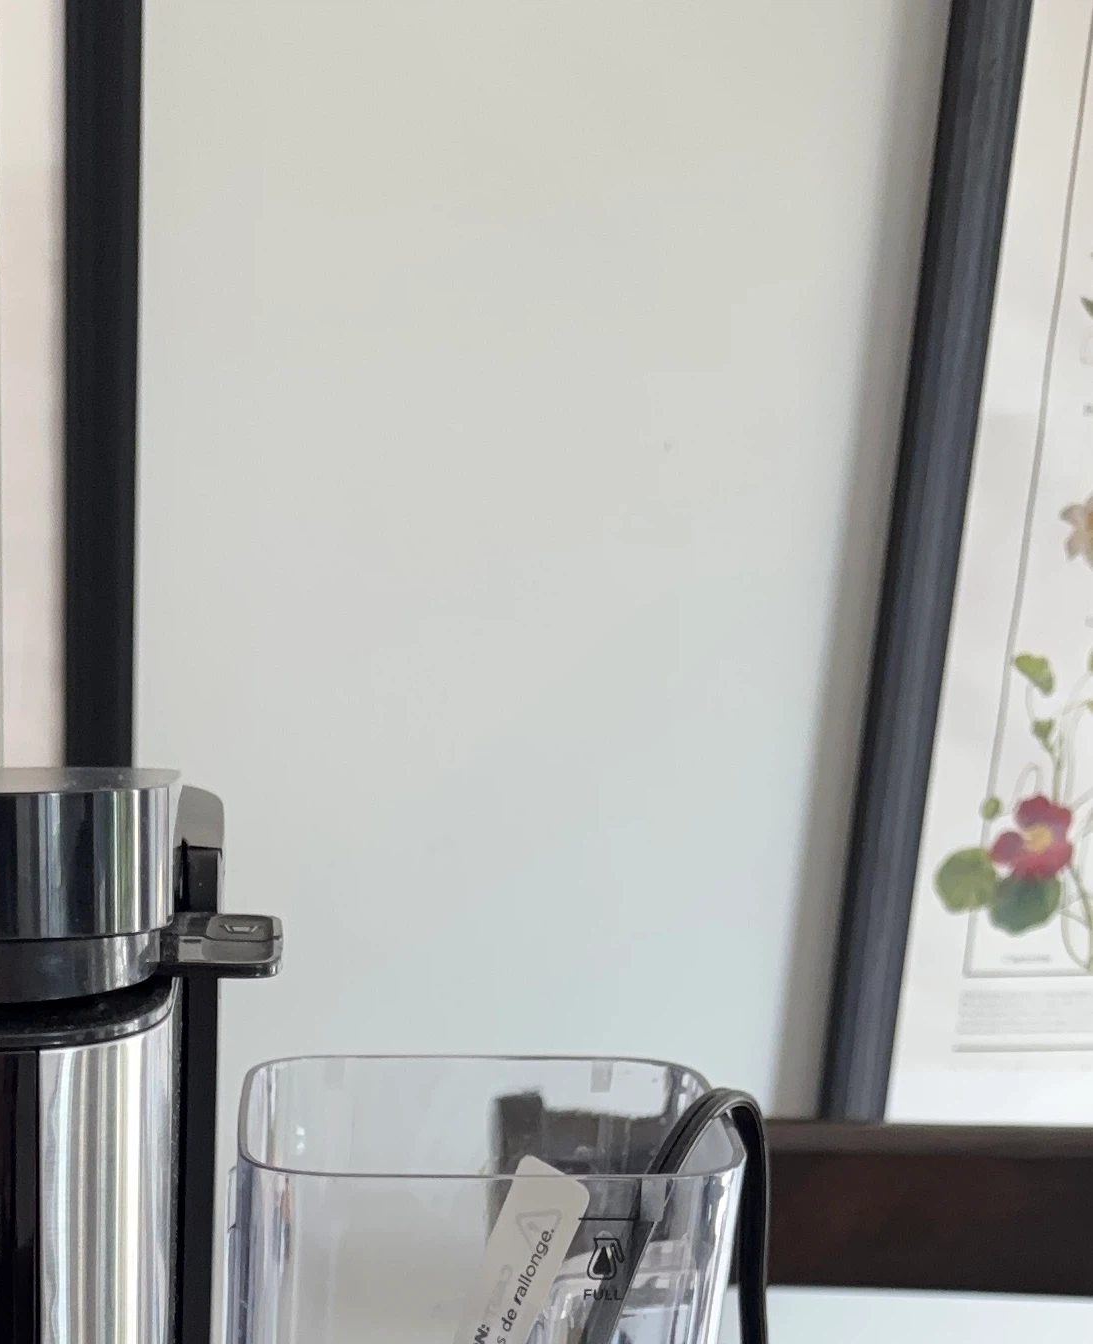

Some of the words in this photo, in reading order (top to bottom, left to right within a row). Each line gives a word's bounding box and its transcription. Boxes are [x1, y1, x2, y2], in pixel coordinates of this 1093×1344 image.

[504, 1307, 518, 1334] de
[514, 1228, 555, 1305] rallonge.
[584, 1289, 623, 1300] FULL
